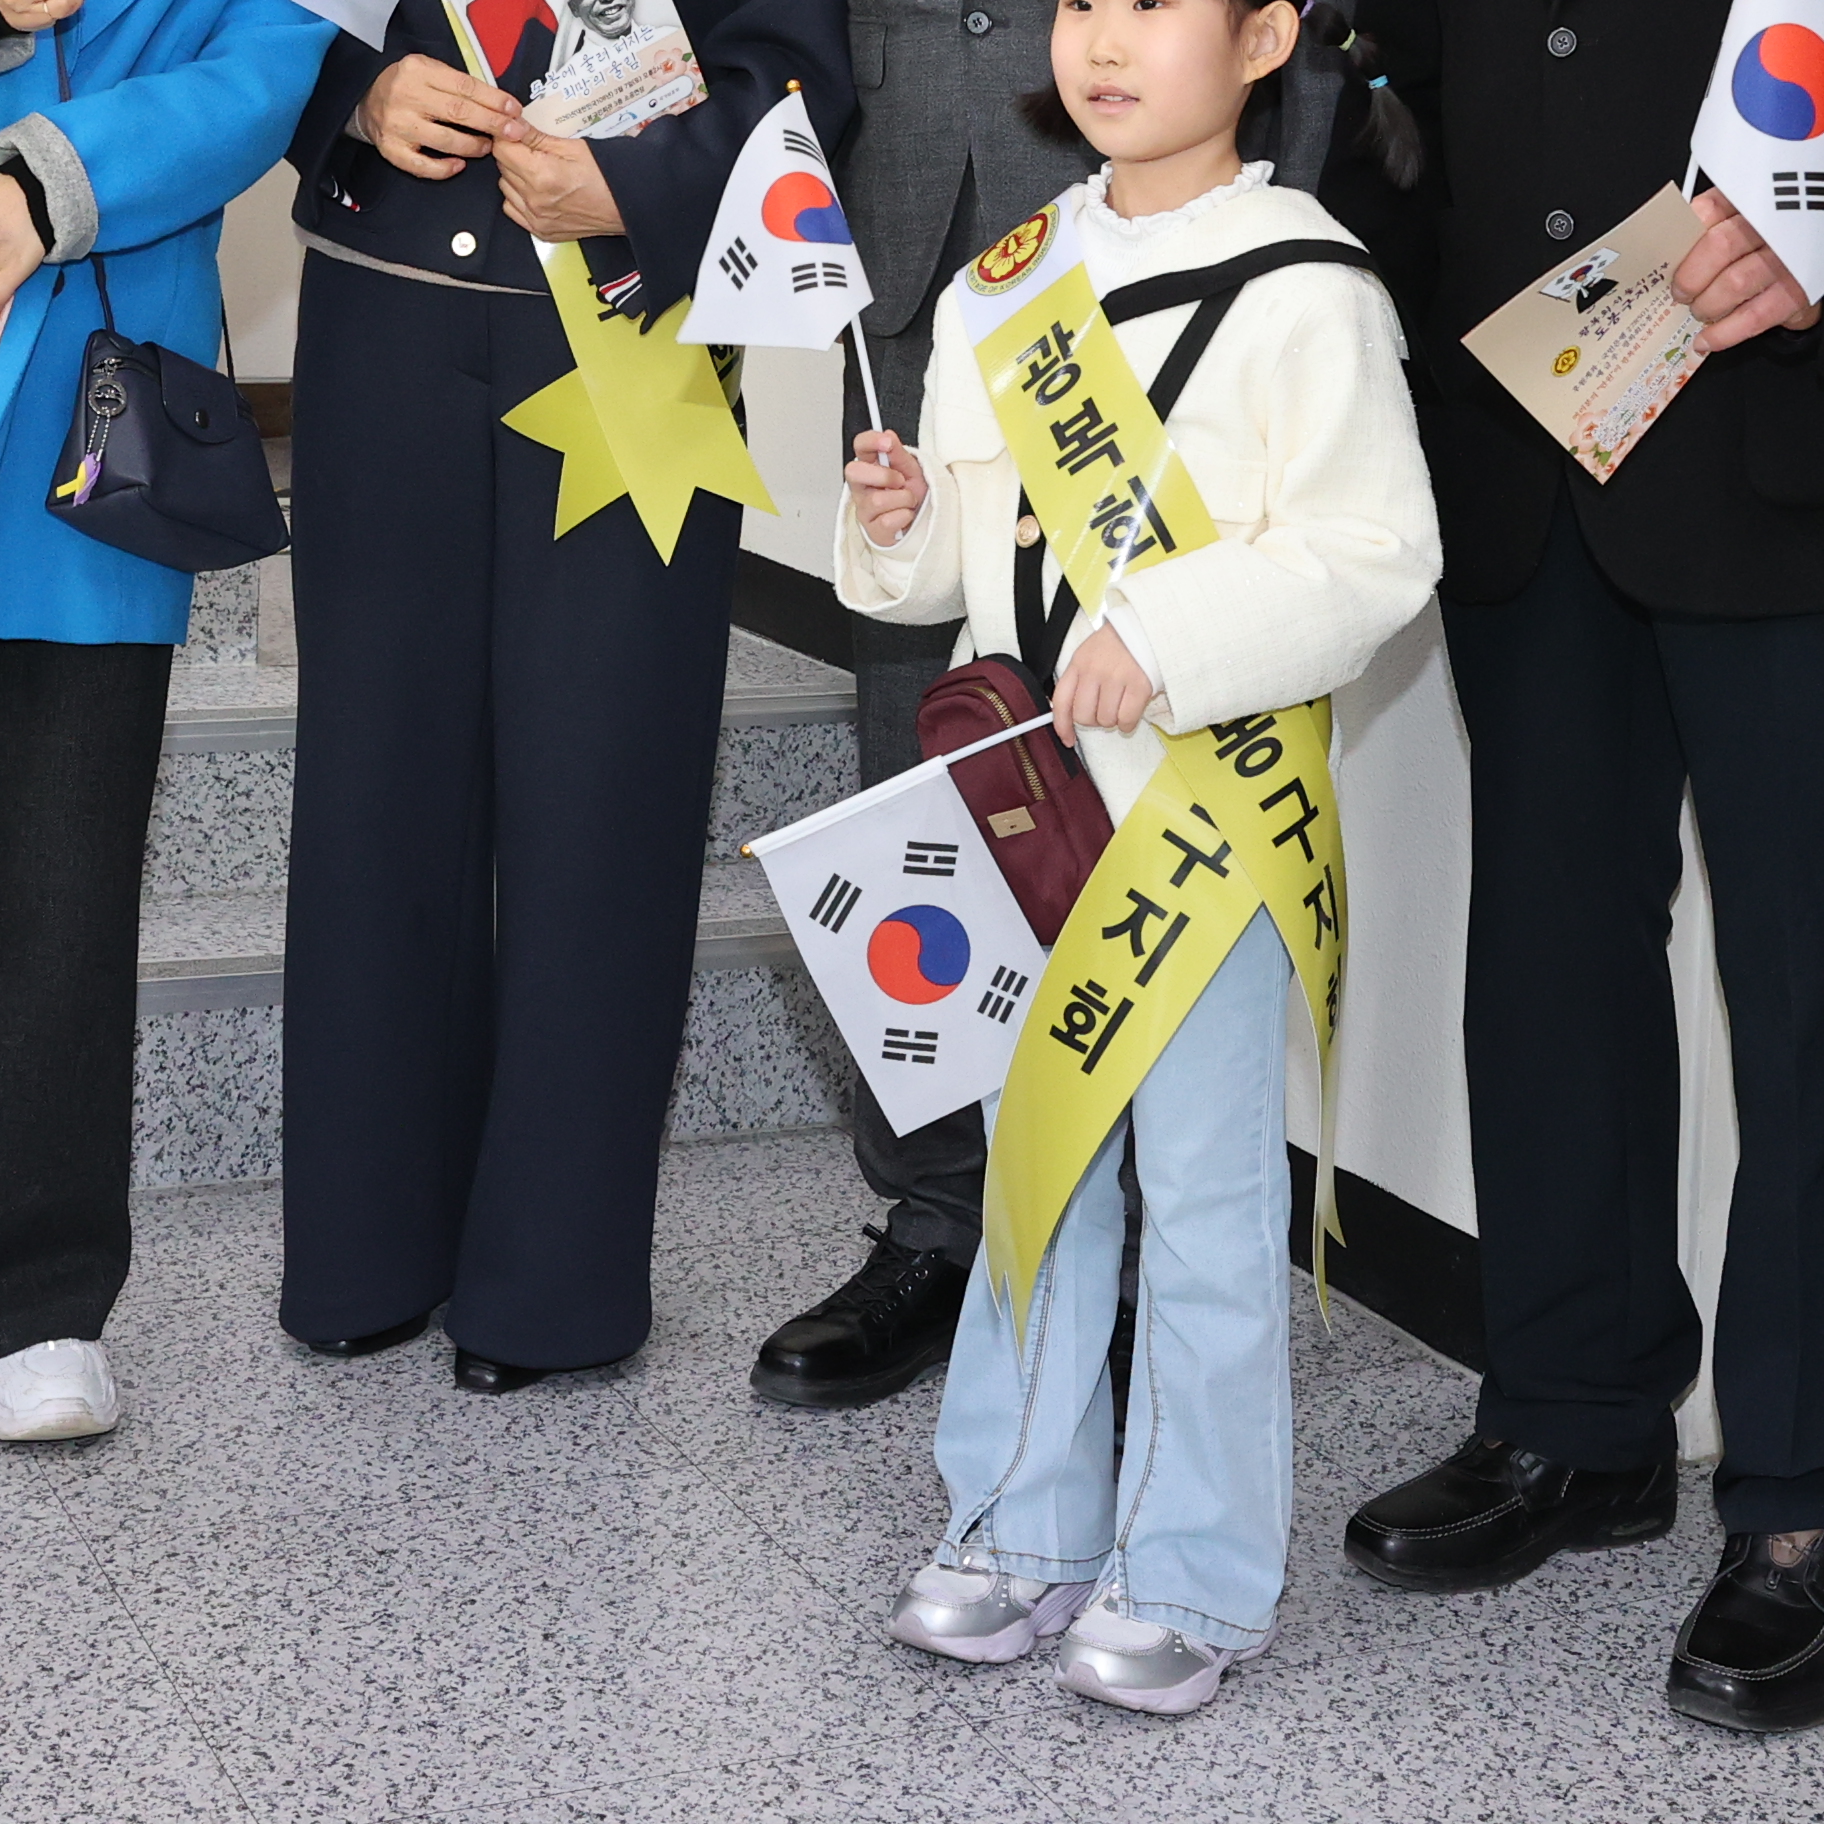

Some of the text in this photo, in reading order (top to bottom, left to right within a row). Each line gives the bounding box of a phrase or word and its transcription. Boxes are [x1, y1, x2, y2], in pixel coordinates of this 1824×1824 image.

[531, 27, 654, 96] 도봉에 울려 퍼지는
[564, 53, 640, 100] 희망의 울림
[1595, 273, 1664, 340] 도봉구지회
[1016, 320, 1177, 569] 광복회
